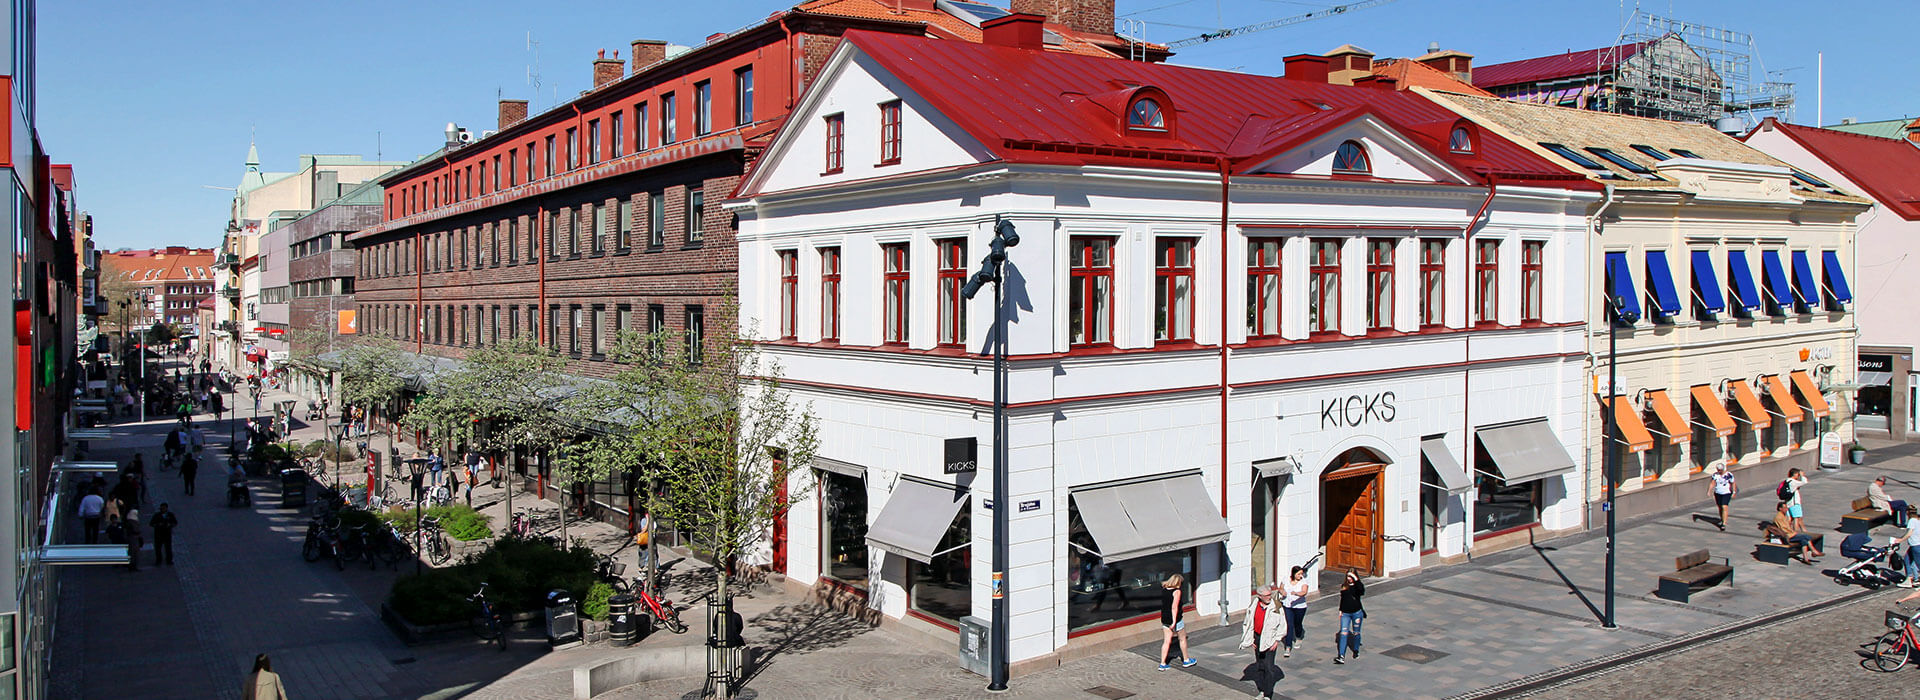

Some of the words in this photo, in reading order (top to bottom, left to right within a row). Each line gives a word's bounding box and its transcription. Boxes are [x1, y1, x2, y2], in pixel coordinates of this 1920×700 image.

[1599, 385, 1624, 393] APEK
[1321, 391, 1396, 431] KICKS
[947, 460, 975, 471] KICKS
